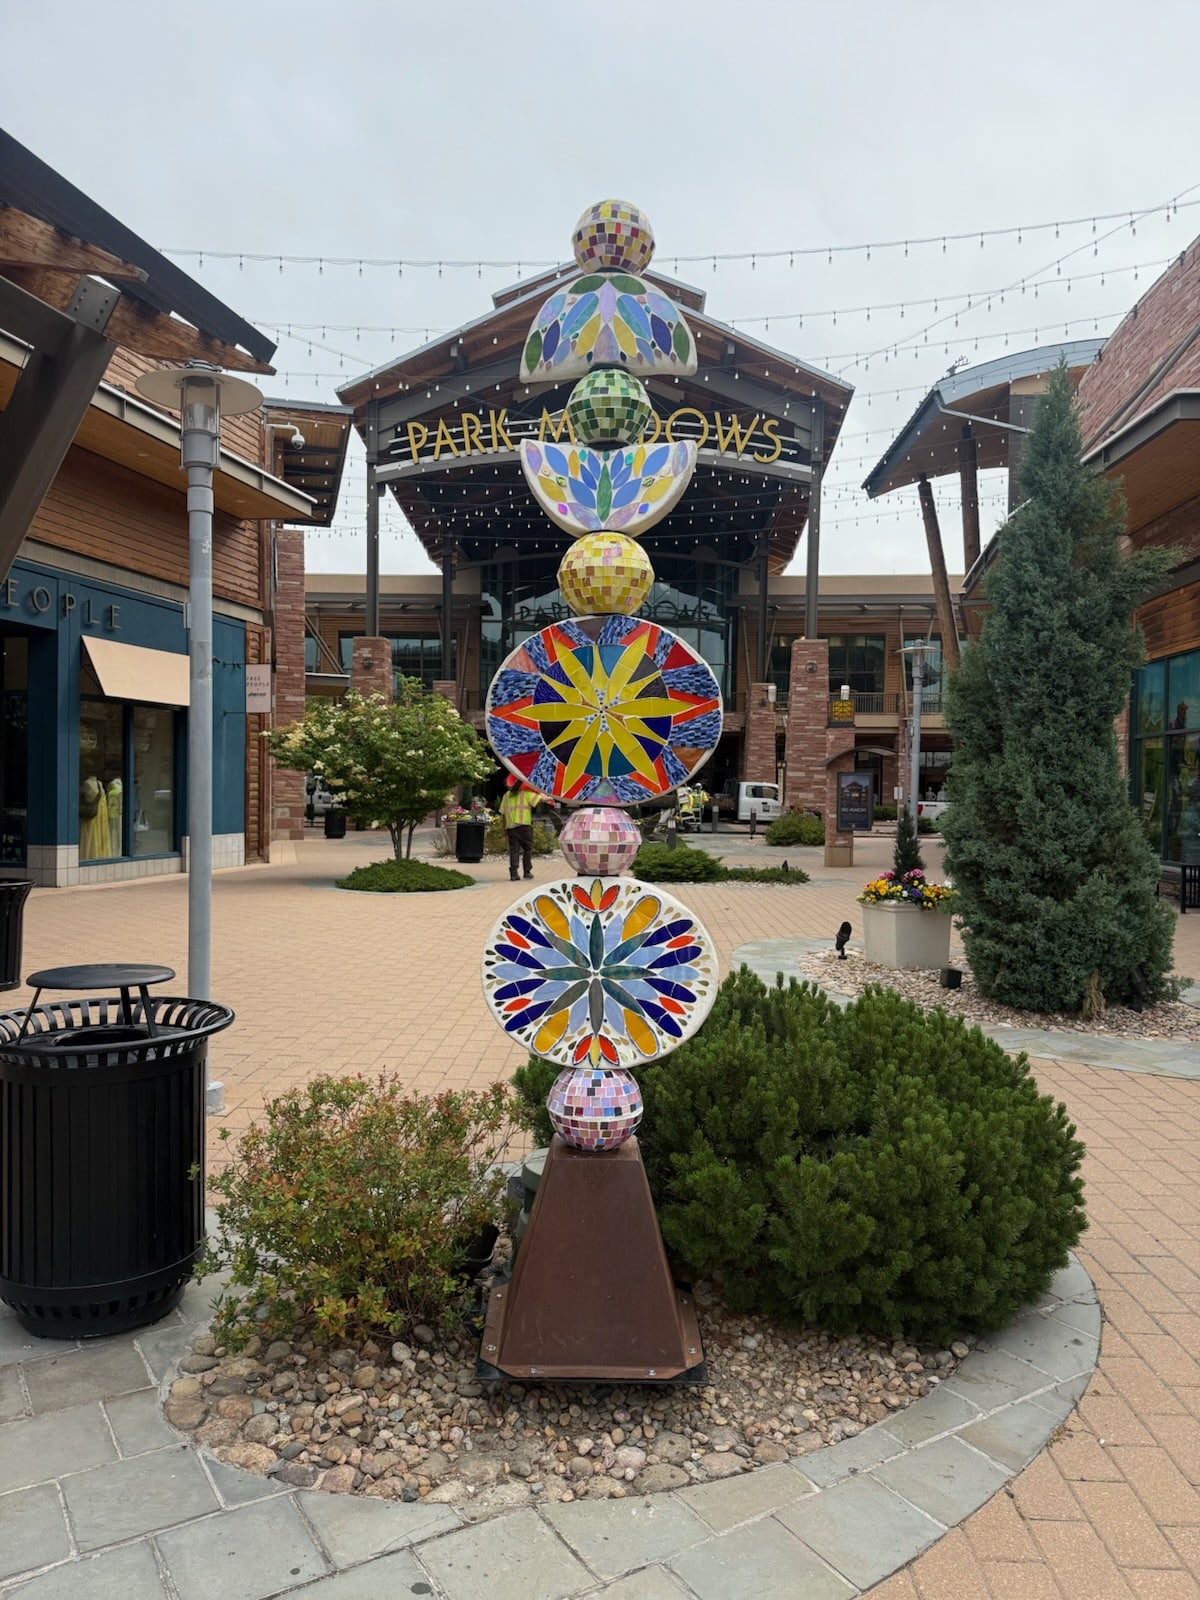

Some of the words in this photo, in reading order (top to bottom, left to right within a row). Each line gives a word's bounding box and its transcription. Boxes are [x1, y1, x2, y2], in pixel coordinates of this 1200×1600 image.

[407, 408, 513, 464] PARK
[537, 406, 782, 463] MDOWS
[6, 579, 121, 628] EOPLE
